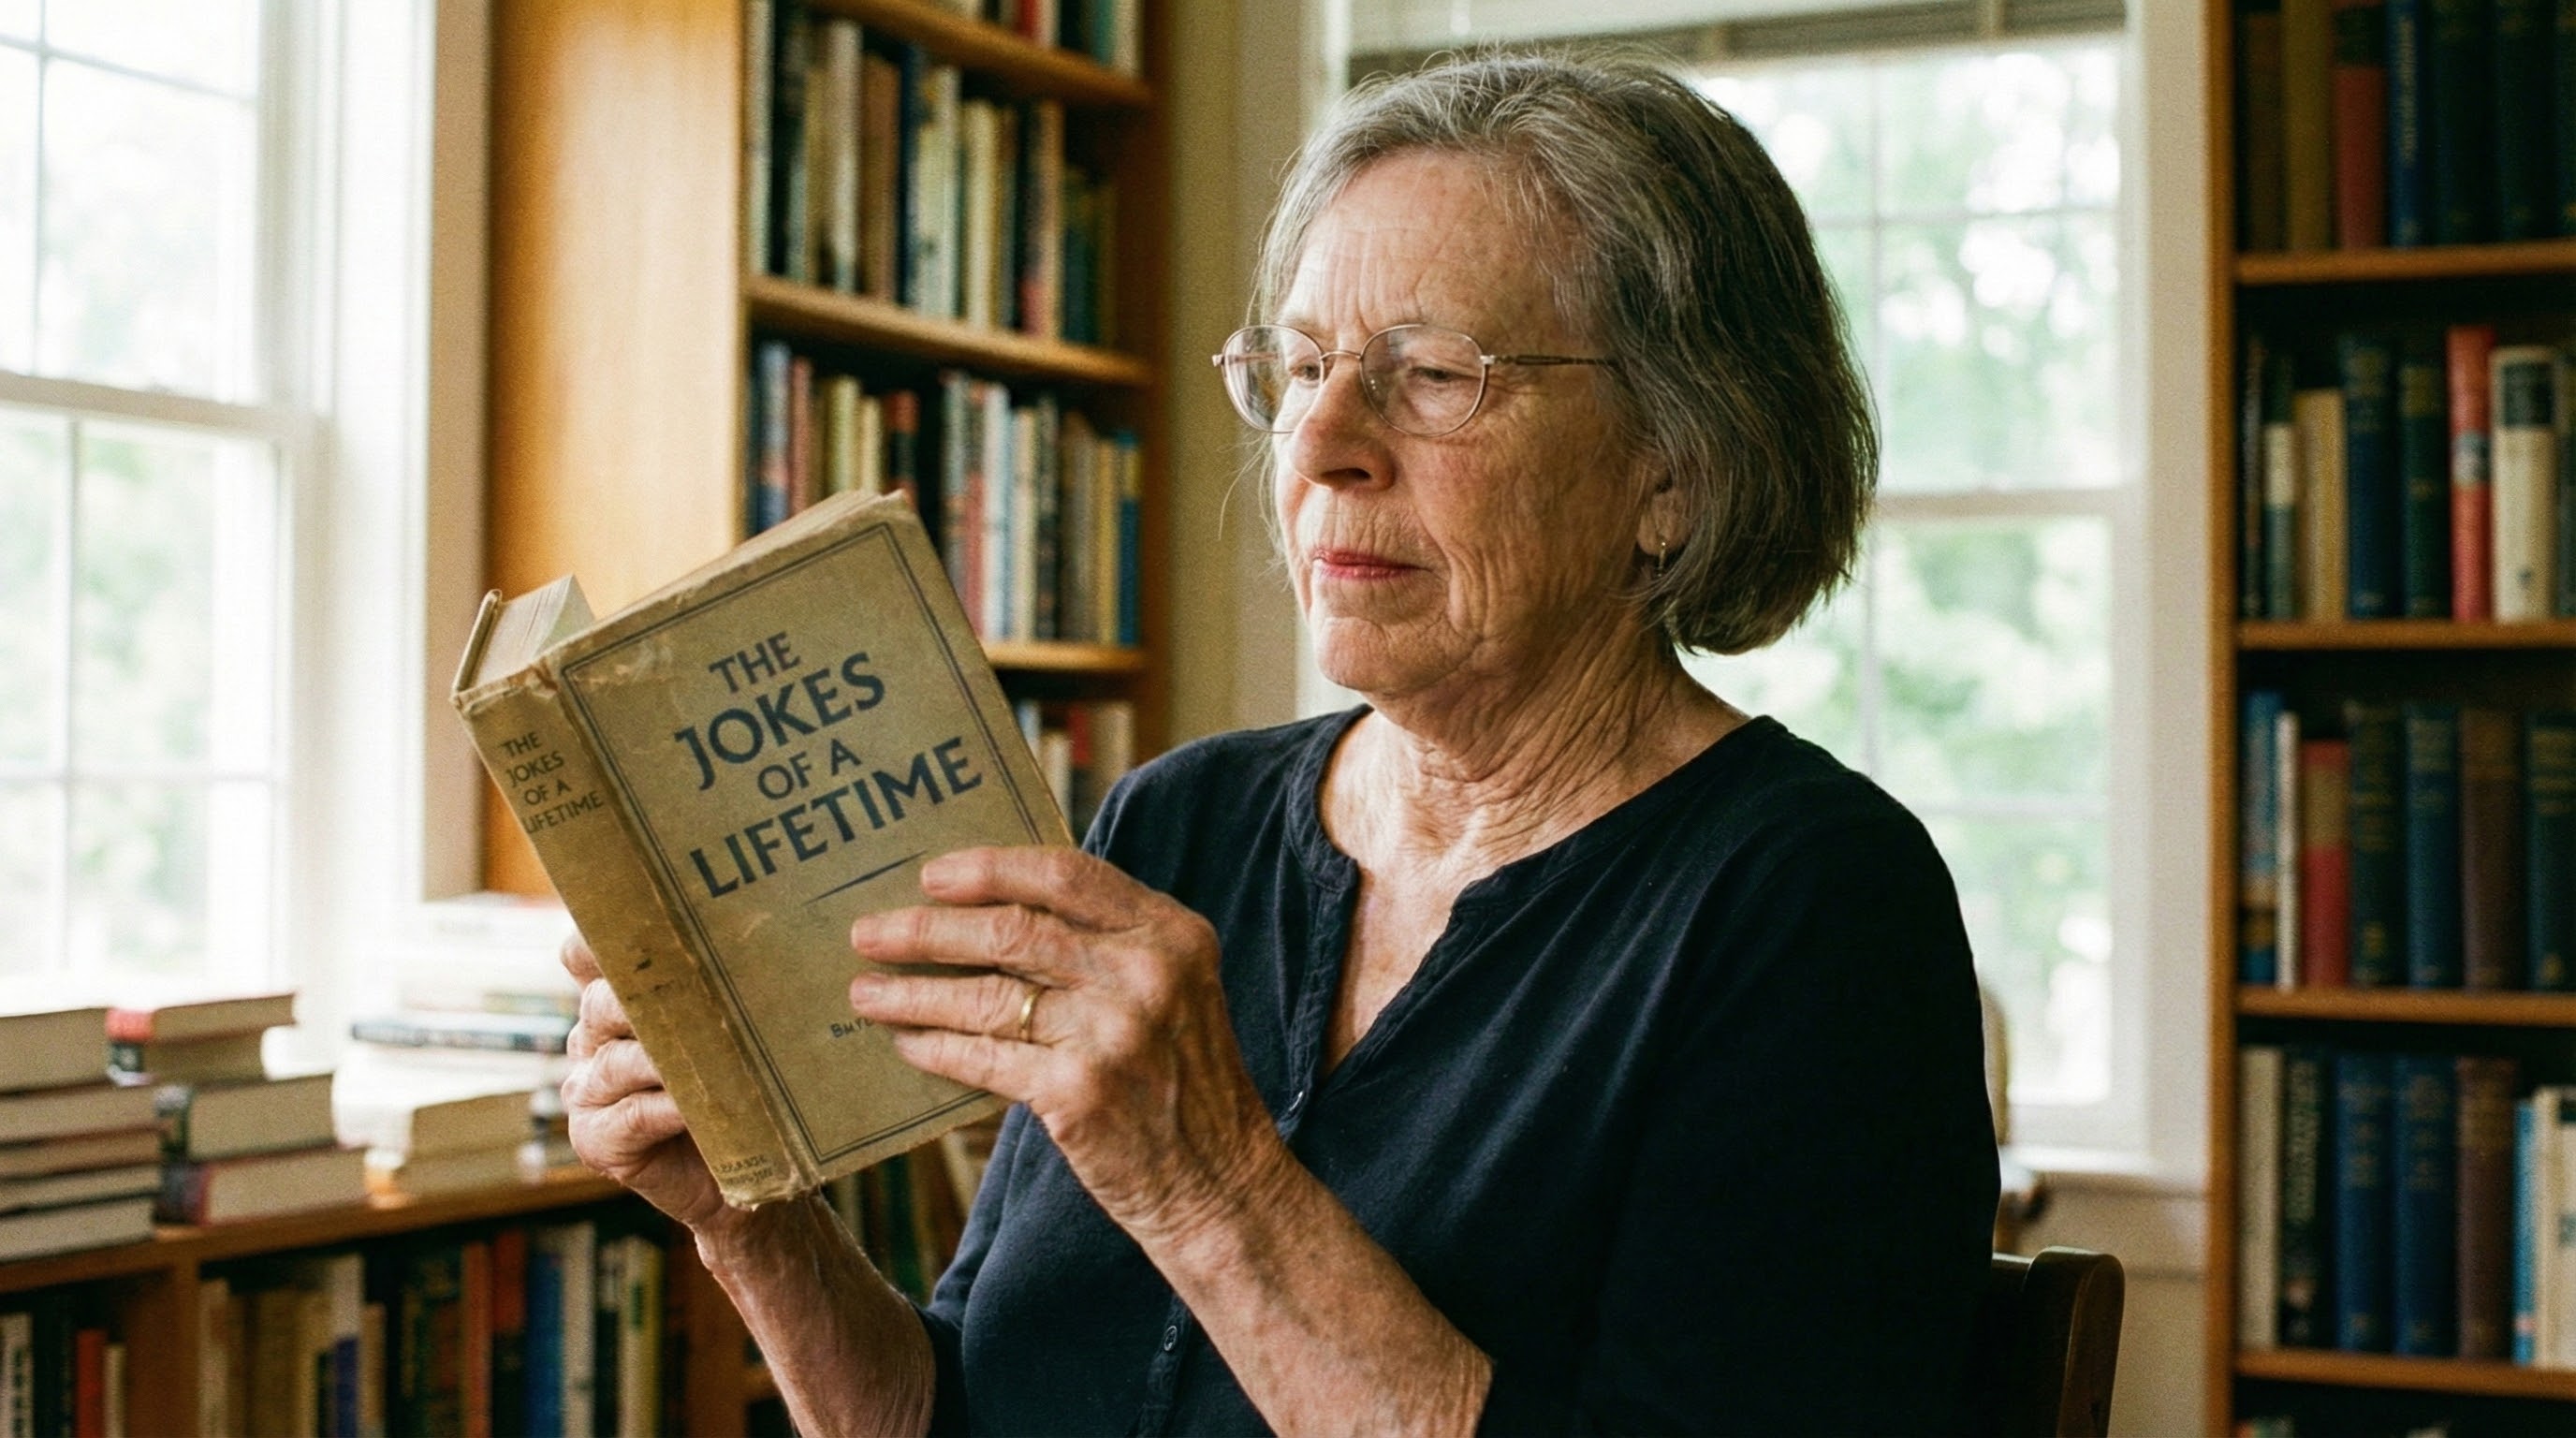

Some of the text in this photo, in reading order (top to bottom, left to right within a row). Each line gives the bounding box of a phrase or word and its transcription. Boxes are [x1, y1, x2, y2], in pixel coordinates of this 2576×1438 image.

[709, 632, 800, 694] THE
[500, 732, 542, 756] THE
[674, 652, 885, 791] JOKES
[506, 751, 564, 787] JOKES
[525, 779, 571, 805] OF A
[757, 738, 862, 800] OF A
[522, 790, 604, 833] LIFETIME
[689, 736, 982, 899] LIFETIME
